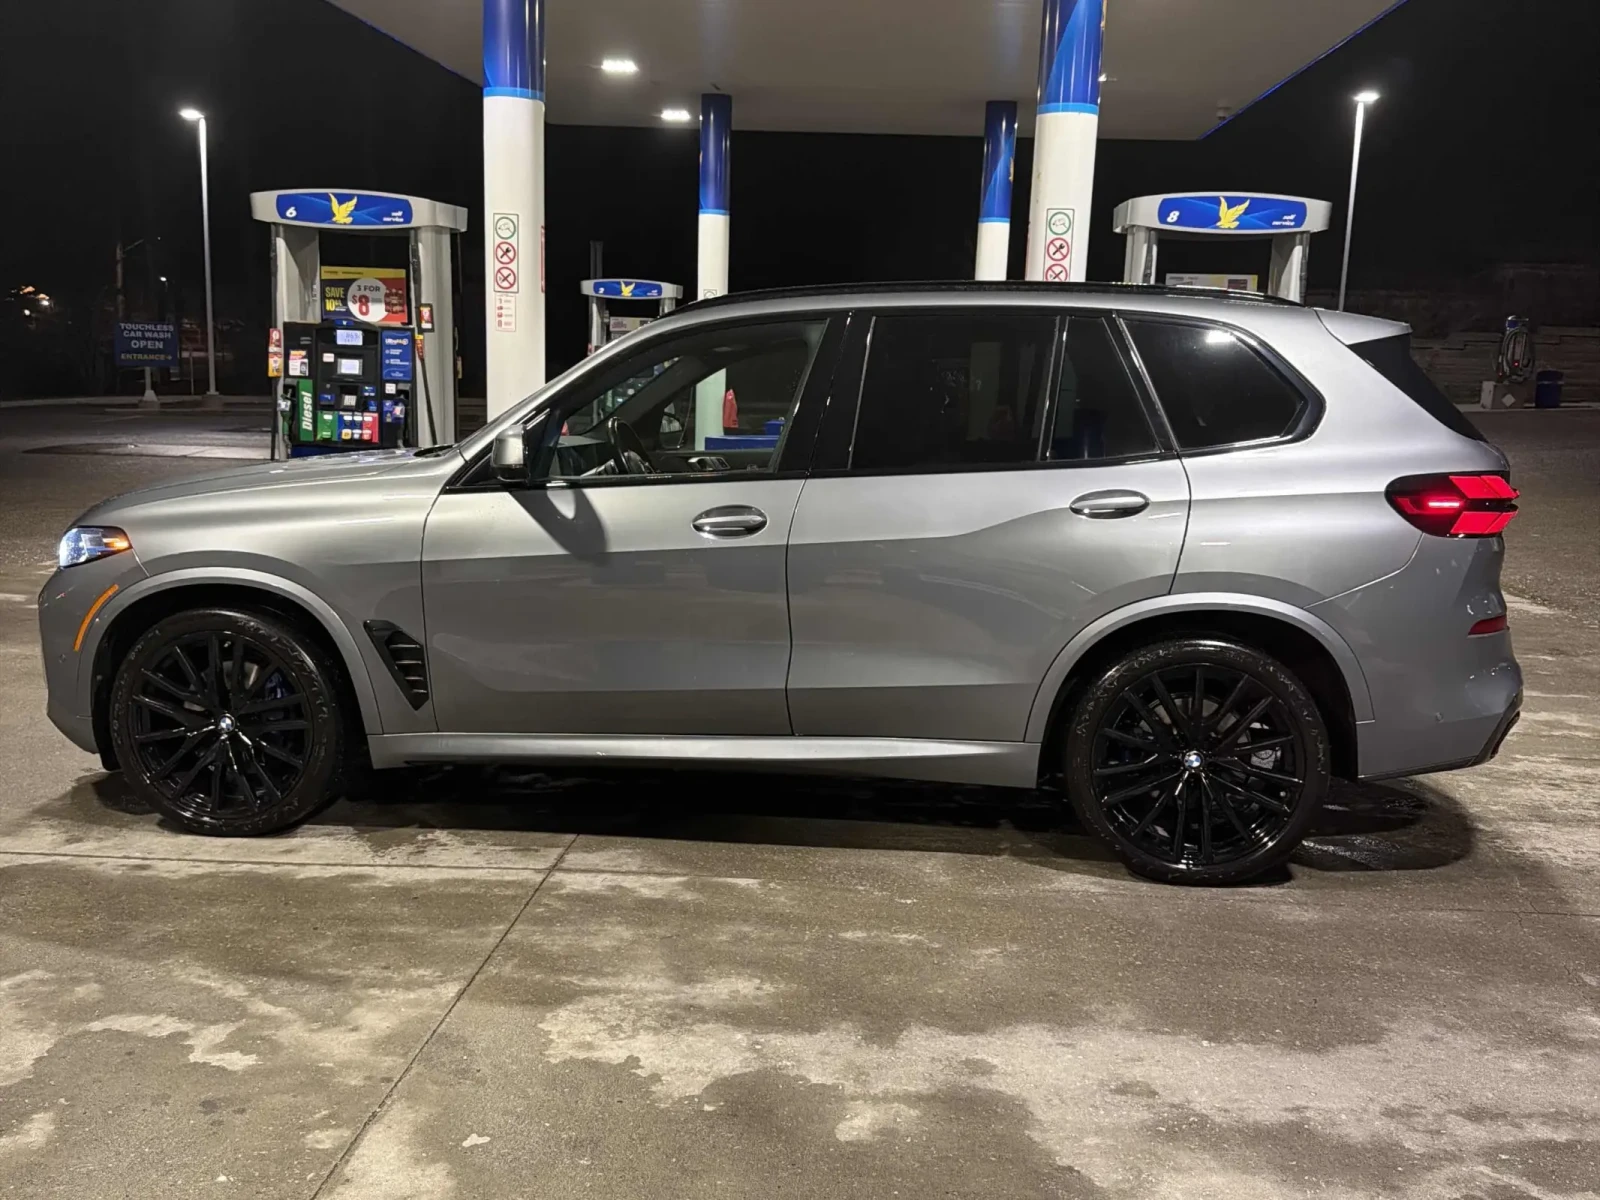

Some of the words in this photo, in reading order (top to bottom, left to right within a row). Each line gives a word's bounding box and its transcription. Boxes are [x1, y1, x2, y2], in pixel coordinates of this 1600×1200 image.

[286, 206, 297, 218] 6
[1167, 211, 1180, 223] 8
[325, 287, 345, 298] SAVE
[352, 295, 370, 316] $8
[119, 323, 174, 331] TOUCHLESS
[131, 340, 164, 349] OPEN
[301, 391, 313, 431] Diesel
